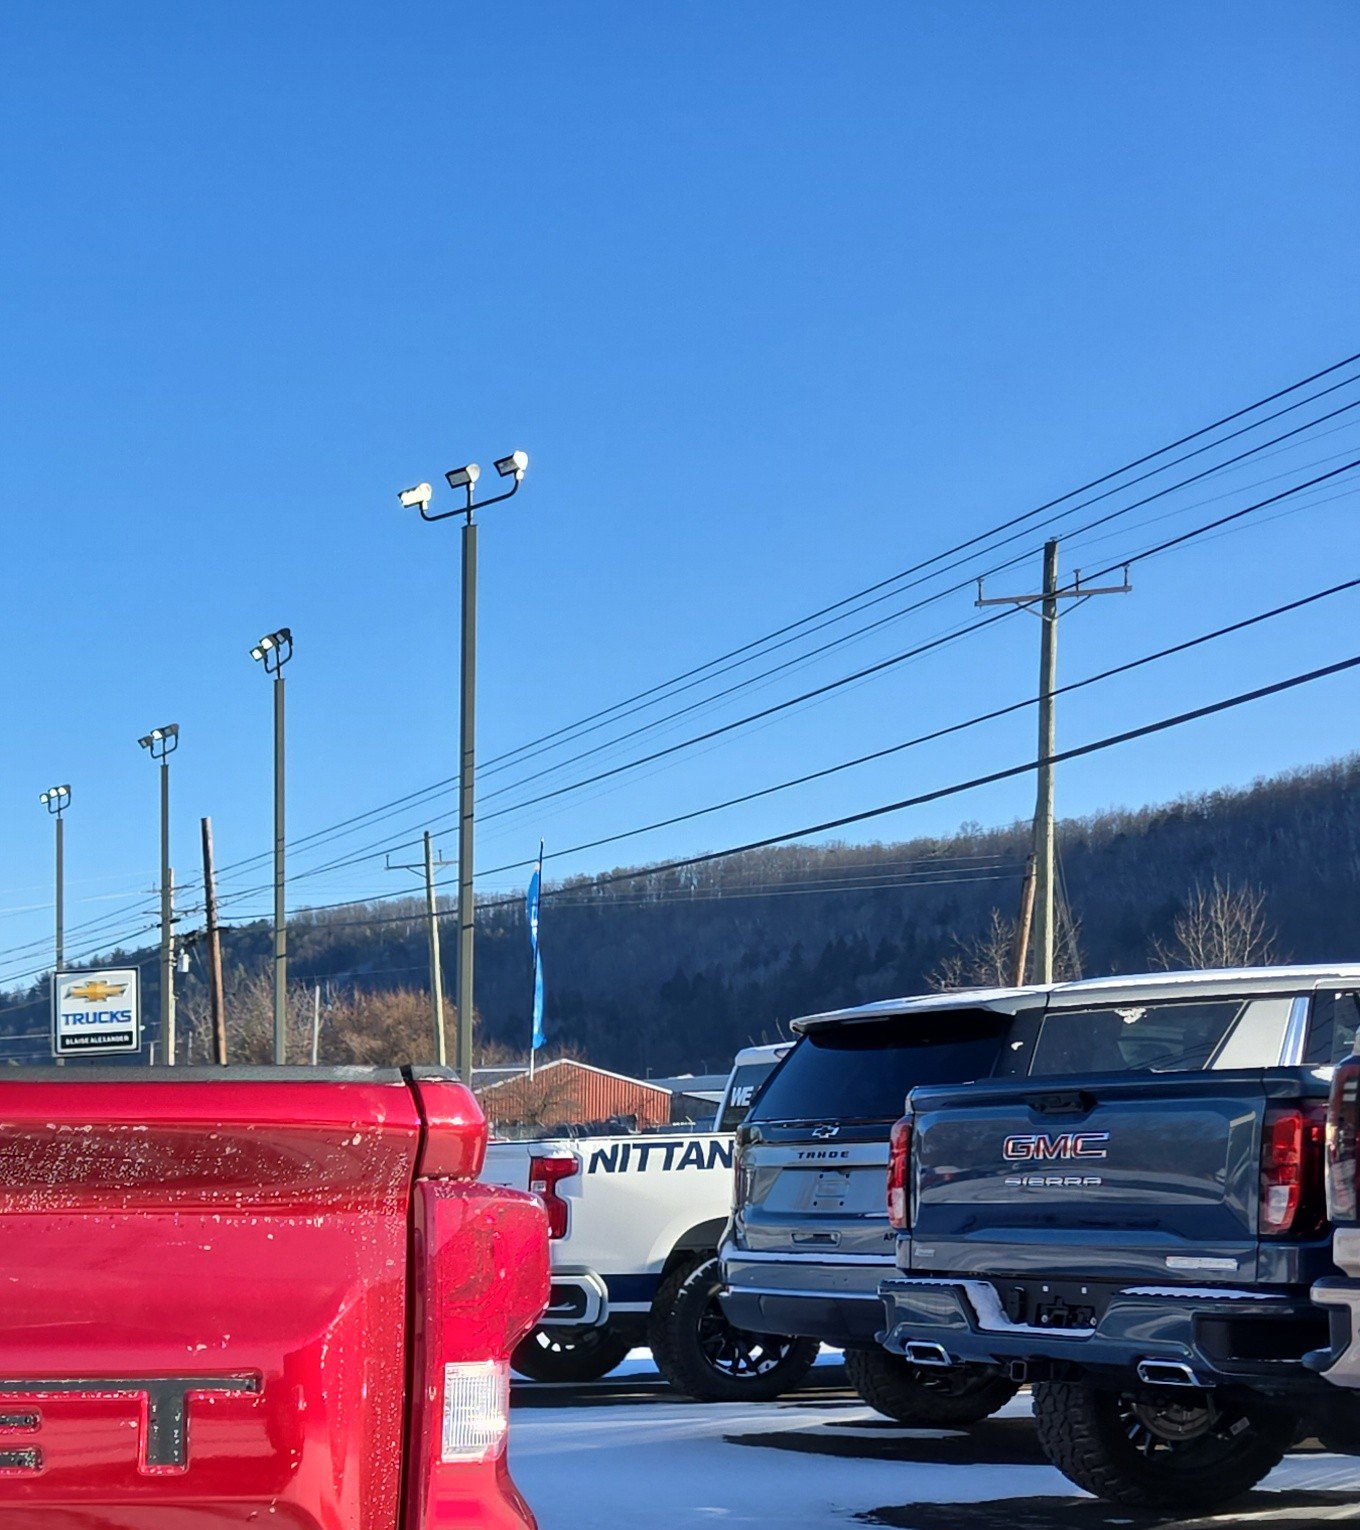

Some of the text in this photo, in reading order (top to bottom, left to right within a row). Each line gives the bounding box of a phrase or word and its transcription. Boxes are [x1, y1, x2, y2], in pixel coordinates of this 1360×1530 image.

[61, 1010, 132, 1026] TRUCKS
[65, 1034, 130, 1046] BLAISE ALEXANDER
[1003, 1132, 1110, 1160] GMC
[797, 1150, 850, 1160] TAHOE
[1004, 1176, 1103, 1188] SIERRA
